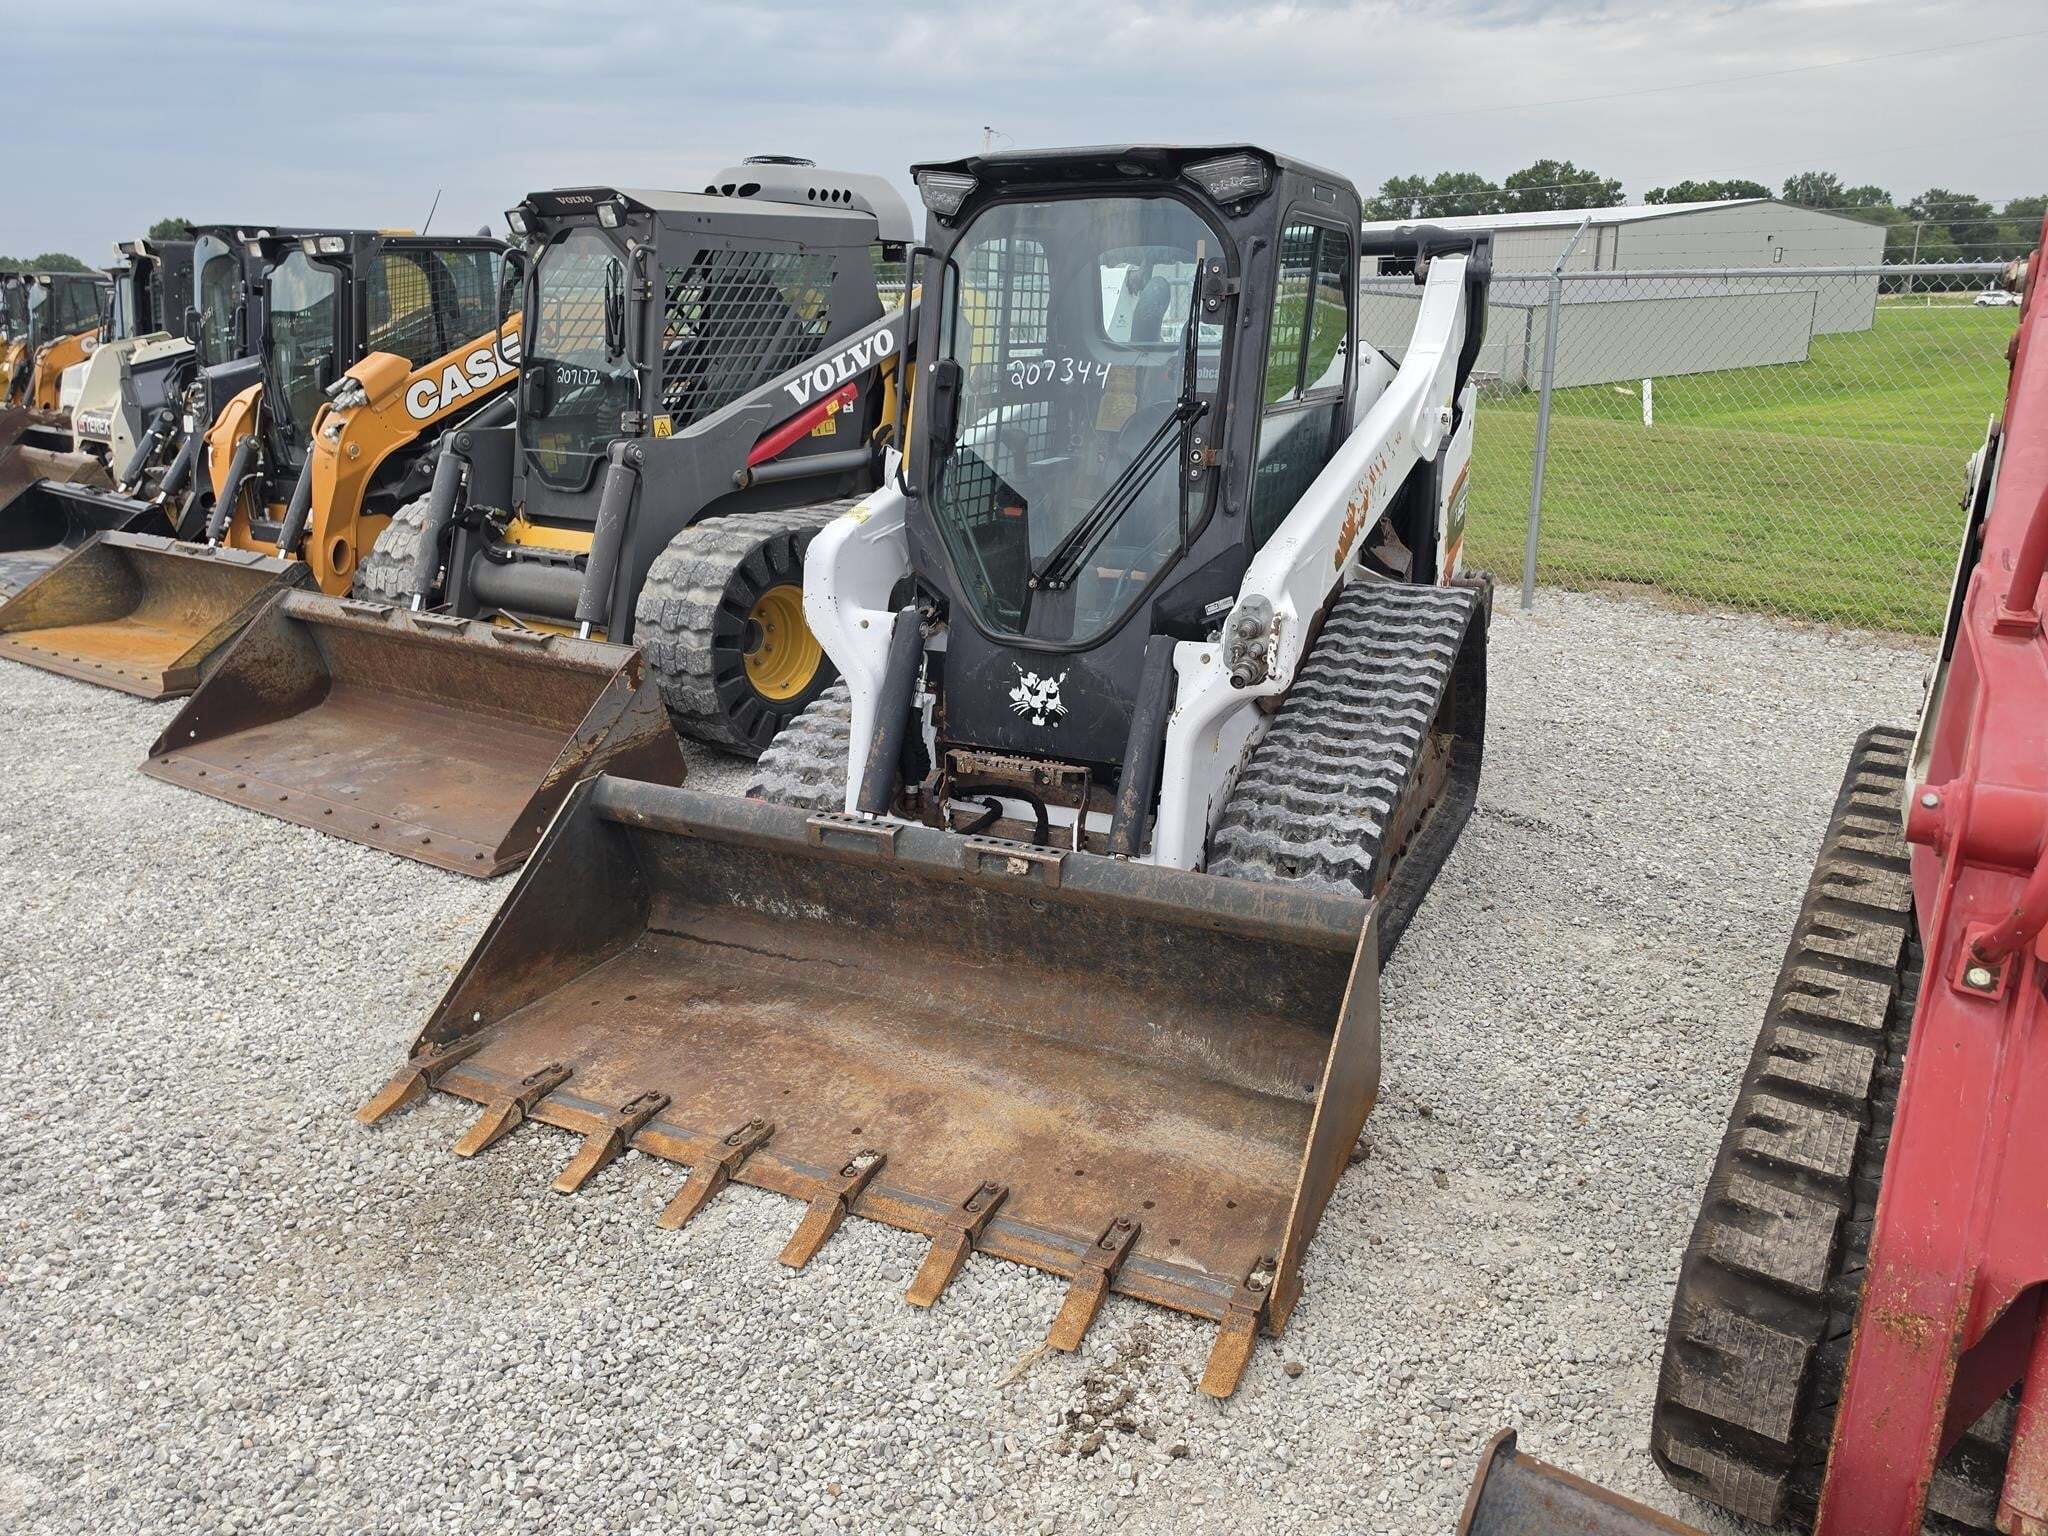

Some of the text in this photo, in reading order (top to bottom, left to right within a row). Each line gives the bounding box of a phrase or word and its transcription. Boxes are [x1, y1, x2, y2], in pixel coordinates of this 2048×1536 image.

[555, 195, 593, 205] VOLVO
[405, 331, 520, 420] CASE
[556, 367, 601, 385] 207177
[783, 328, 895, 405] VOLVO
[1011, 357, 1112, 390] 207344
